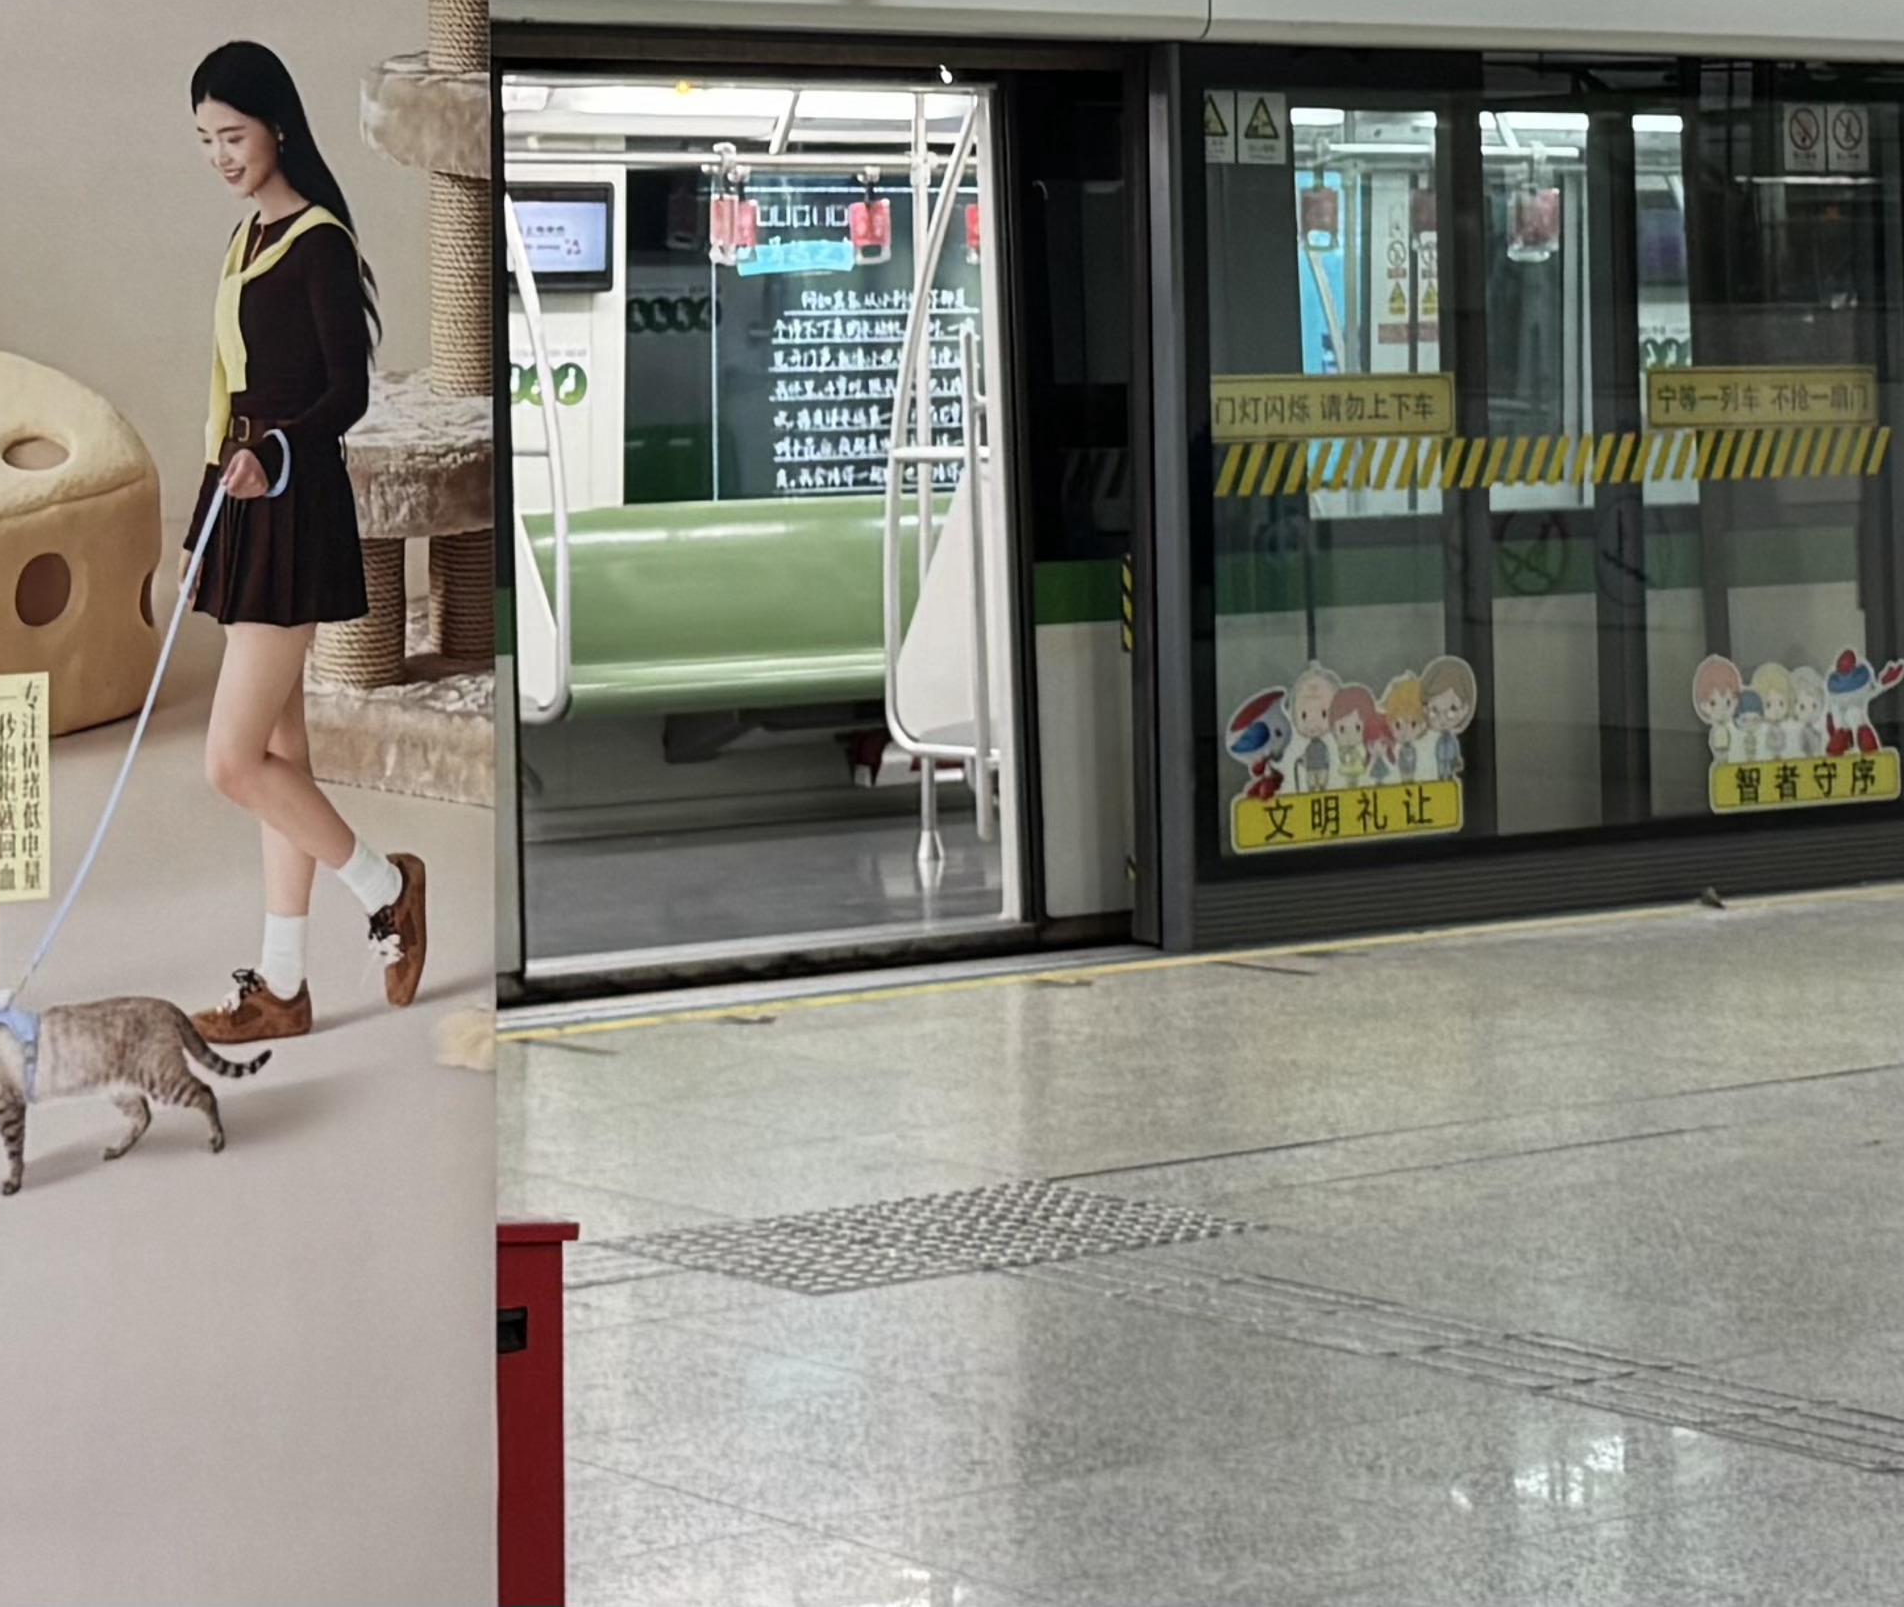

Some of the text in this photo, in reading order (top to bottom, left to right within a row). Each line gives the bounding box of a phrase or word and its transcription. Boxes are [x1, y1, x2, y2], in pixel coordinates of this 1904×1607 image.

[1320, 390, 1434, 424] 请勿上下车
[1734, 757, 1876, 806] 智者守序
[1263, 784, 1434, 844] 文明礼让
